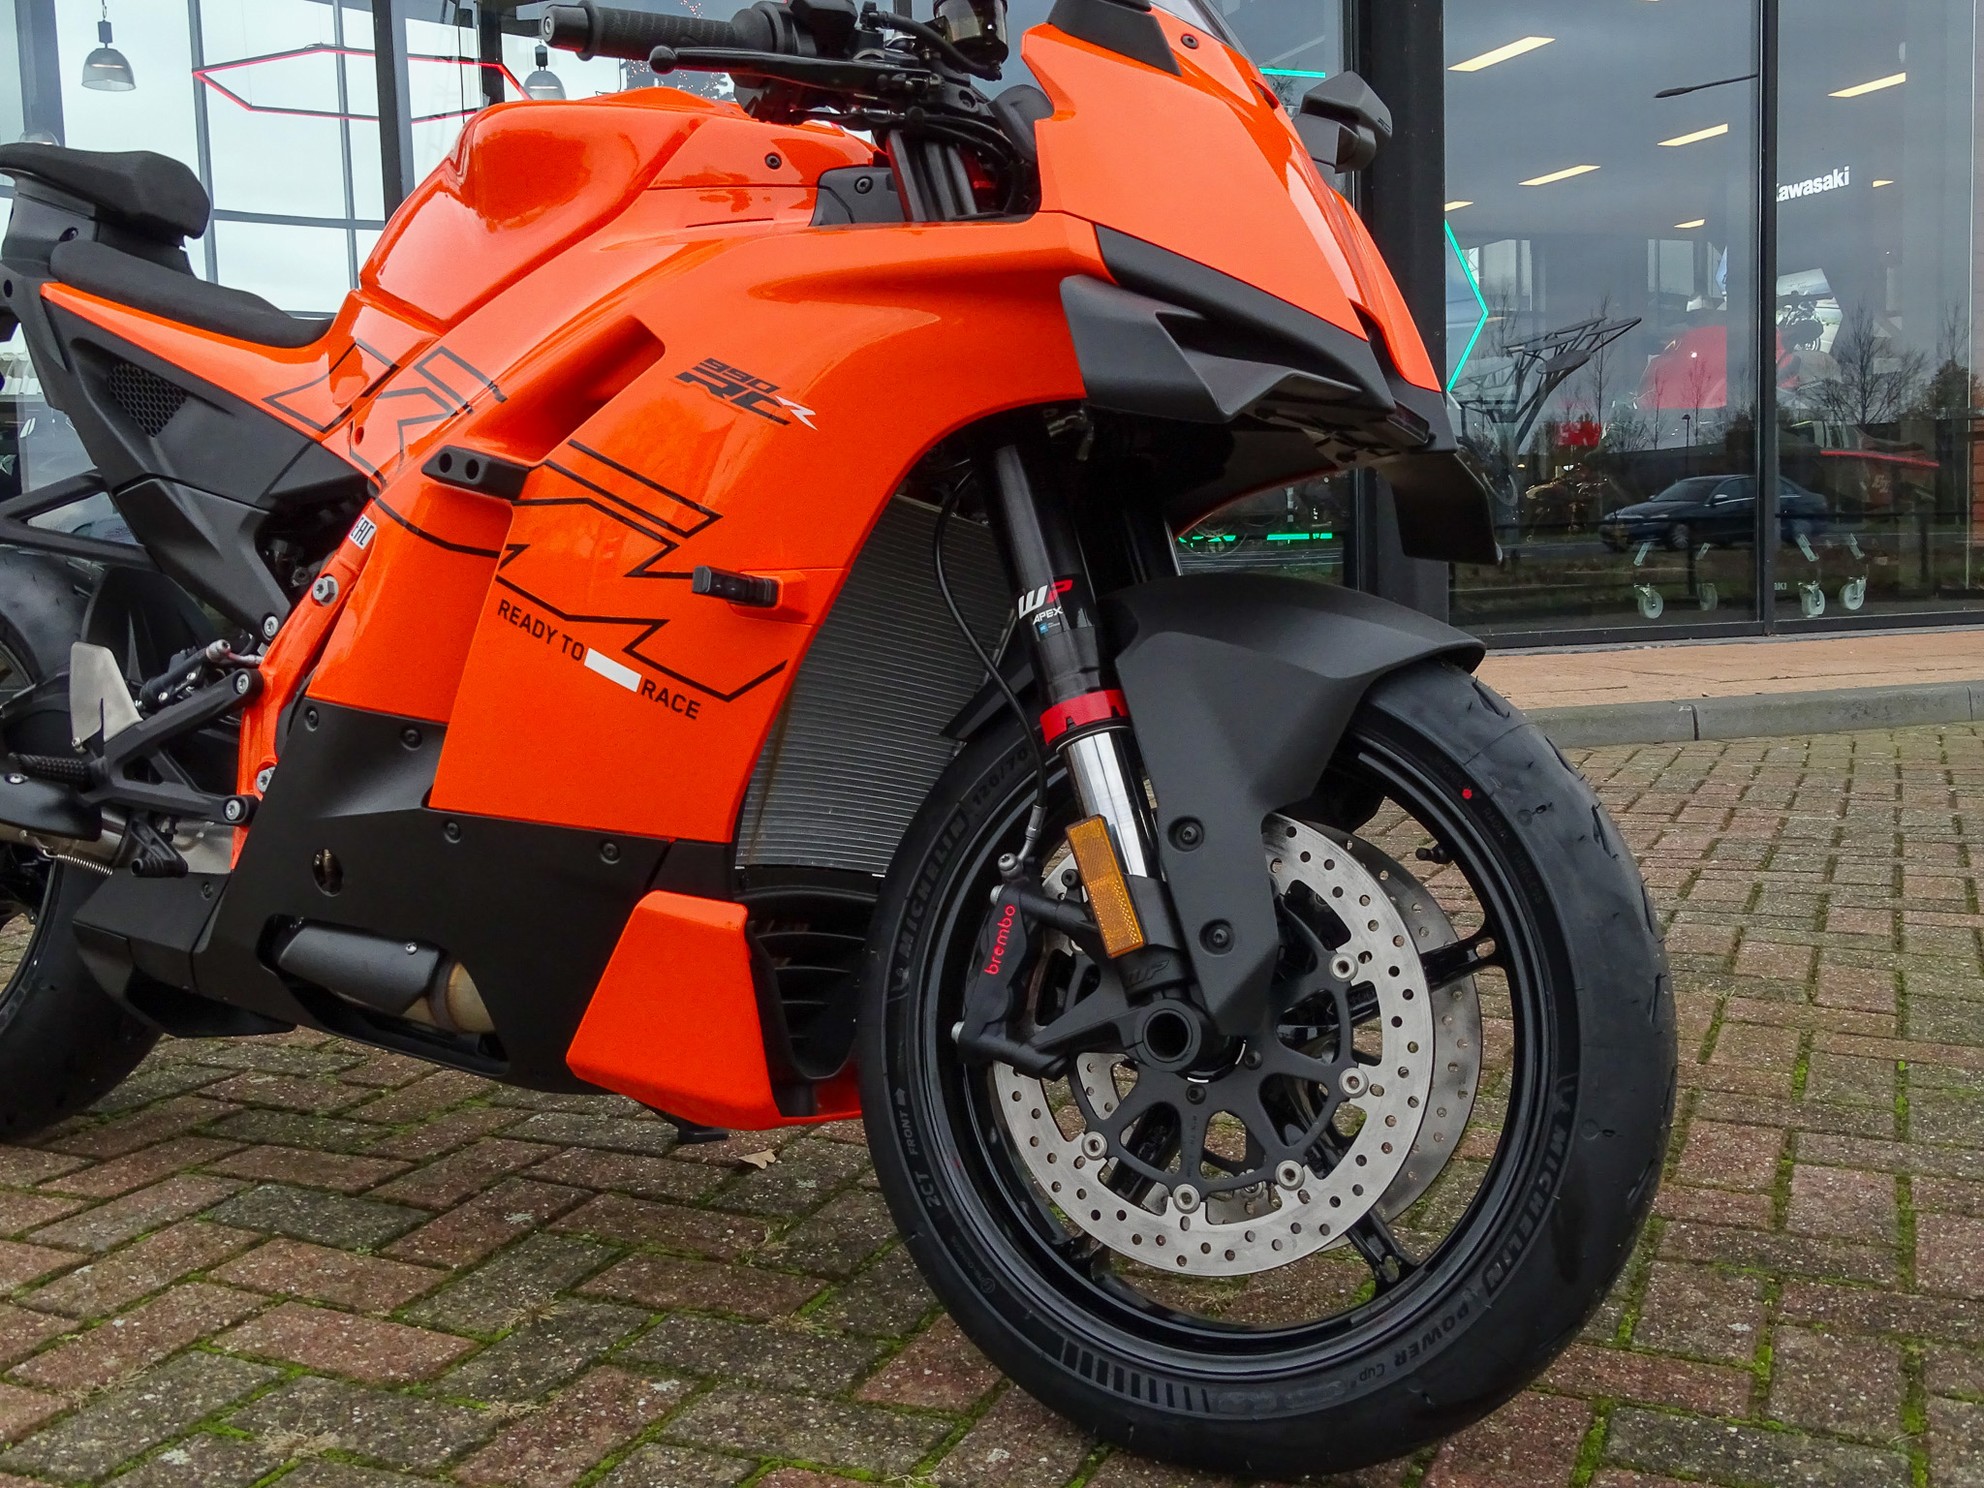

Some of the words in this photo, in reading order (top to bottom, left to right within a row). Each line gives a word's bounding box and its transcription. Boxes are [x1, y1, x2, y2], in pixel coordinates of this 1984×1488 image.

[1776, 165, 1850, 203] awasaki
[1018, 579, 1073, 620] WP
[1032, 606, 1063, 625] APEX
[498, 599, 558, 645] READY
[562, 634, 585, 662] TO
[641, 679, 701, 720] RACE
[898, 813, 967, 960] MICHELIN
[984, 904, 1016, 975] brembo
[899, 1110, 919, 1156] FRONT
[1485, 1124, 1567, 1290] MICHELIN
[1394, 1301, 1470, 1368] POWER
